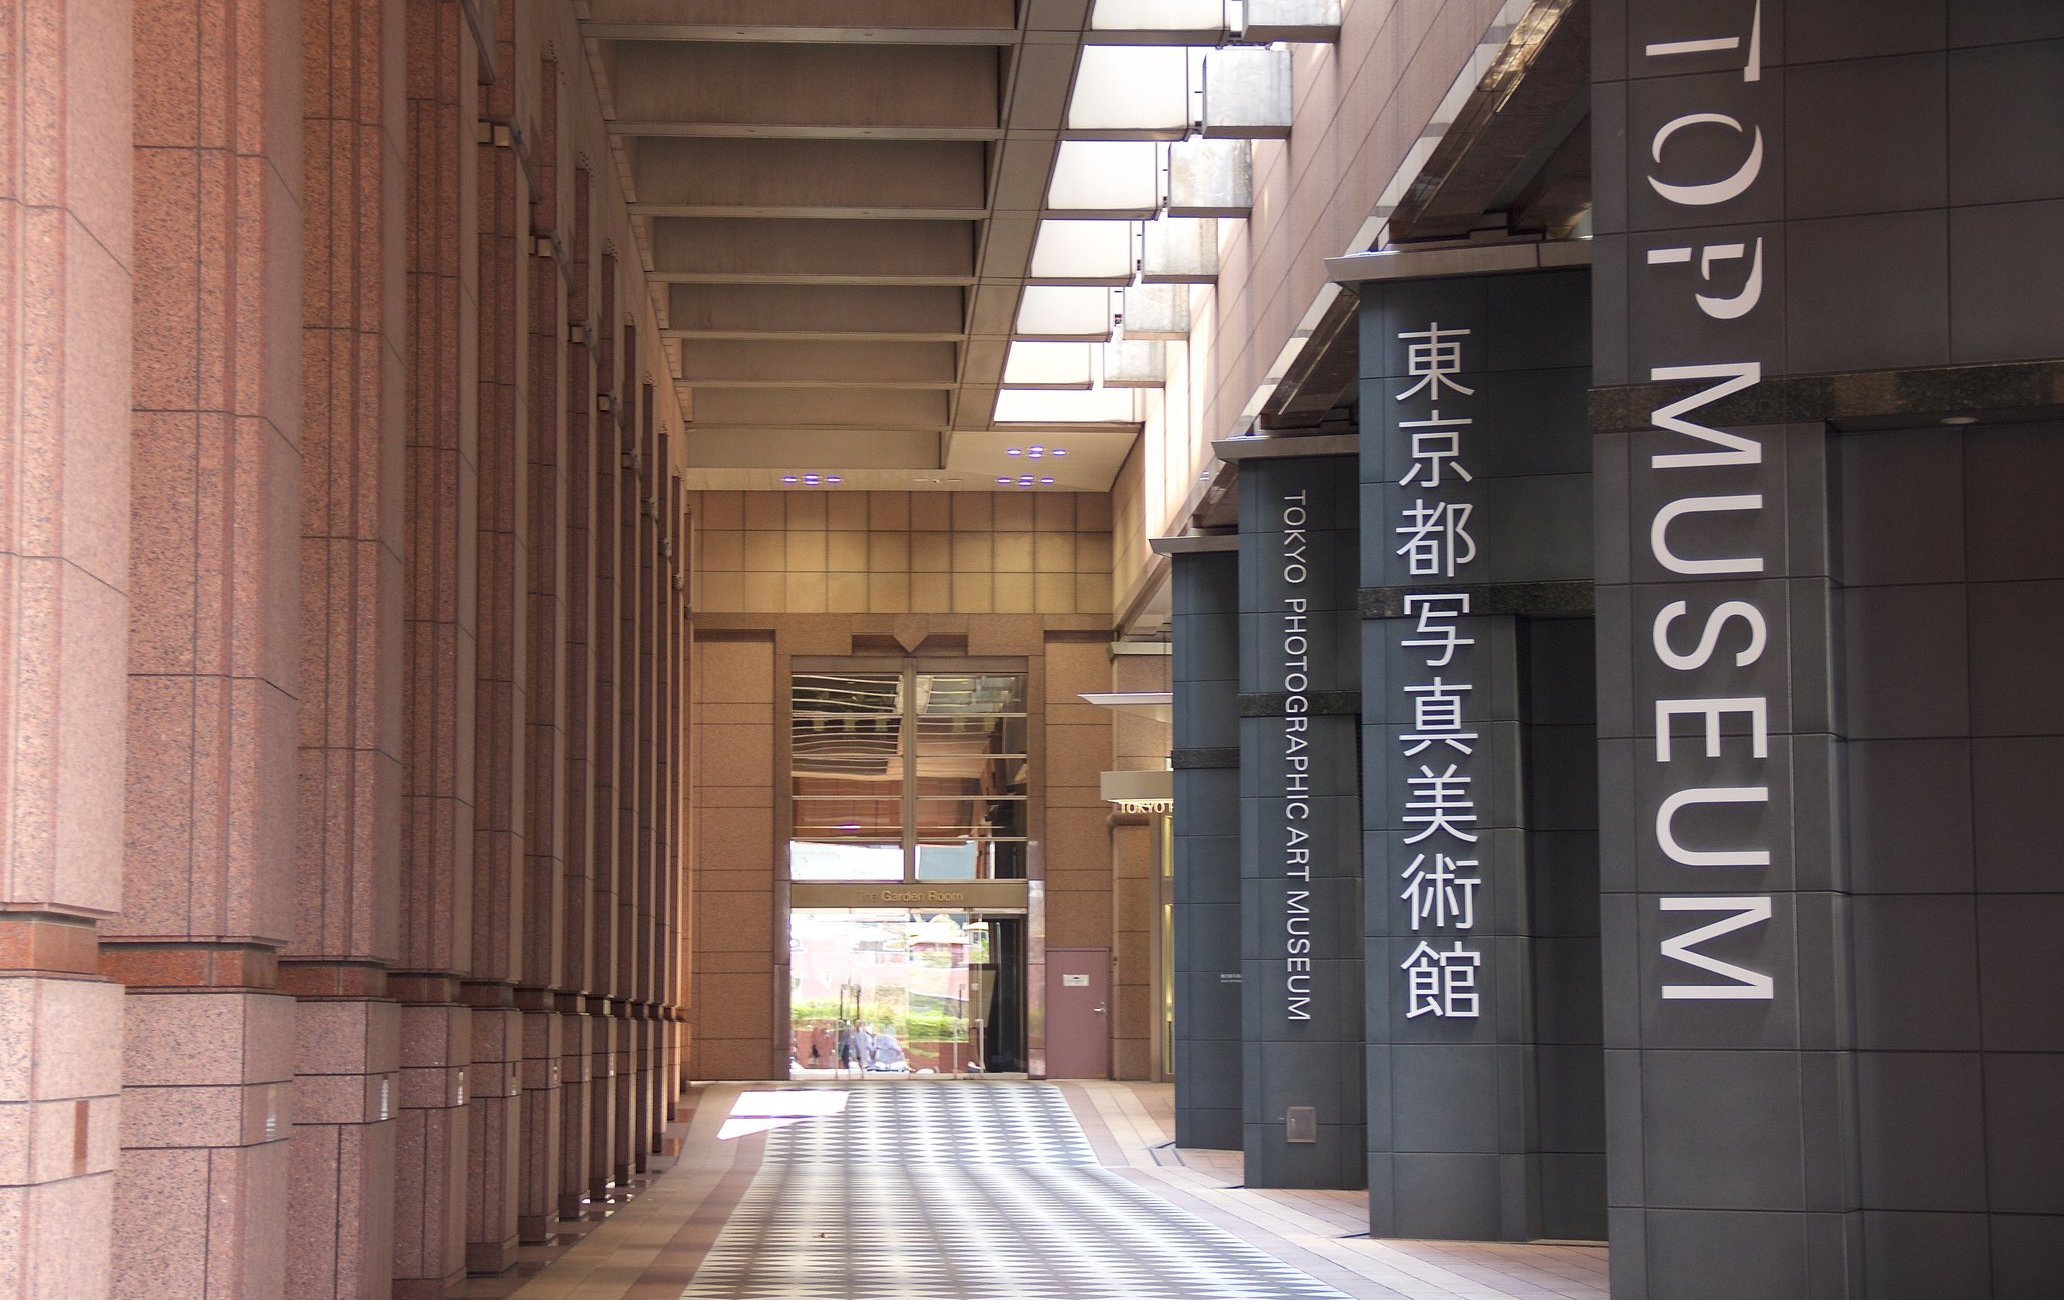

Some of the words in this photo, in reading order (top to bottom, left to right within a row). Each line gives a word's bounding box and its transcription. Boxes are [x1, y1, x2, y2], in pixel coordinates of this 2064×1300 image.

[1645, 0, 1763, 320] TOP
[1283, 489, 1307, 584] TOKYO
[1284, 598, 1310, 820] PHOTOGRAPHIC
[1395, 321, 1482, 1019] 東京都写真美術館
[1651, 361, 1774, 1000] MUSEUM
[882, 890, 924, 901] Garden
[928, 890, 963, 901] Room
[1286, 826, 1310, 882] ART
[1286, 890, 1311, 1020] MUSEUM
